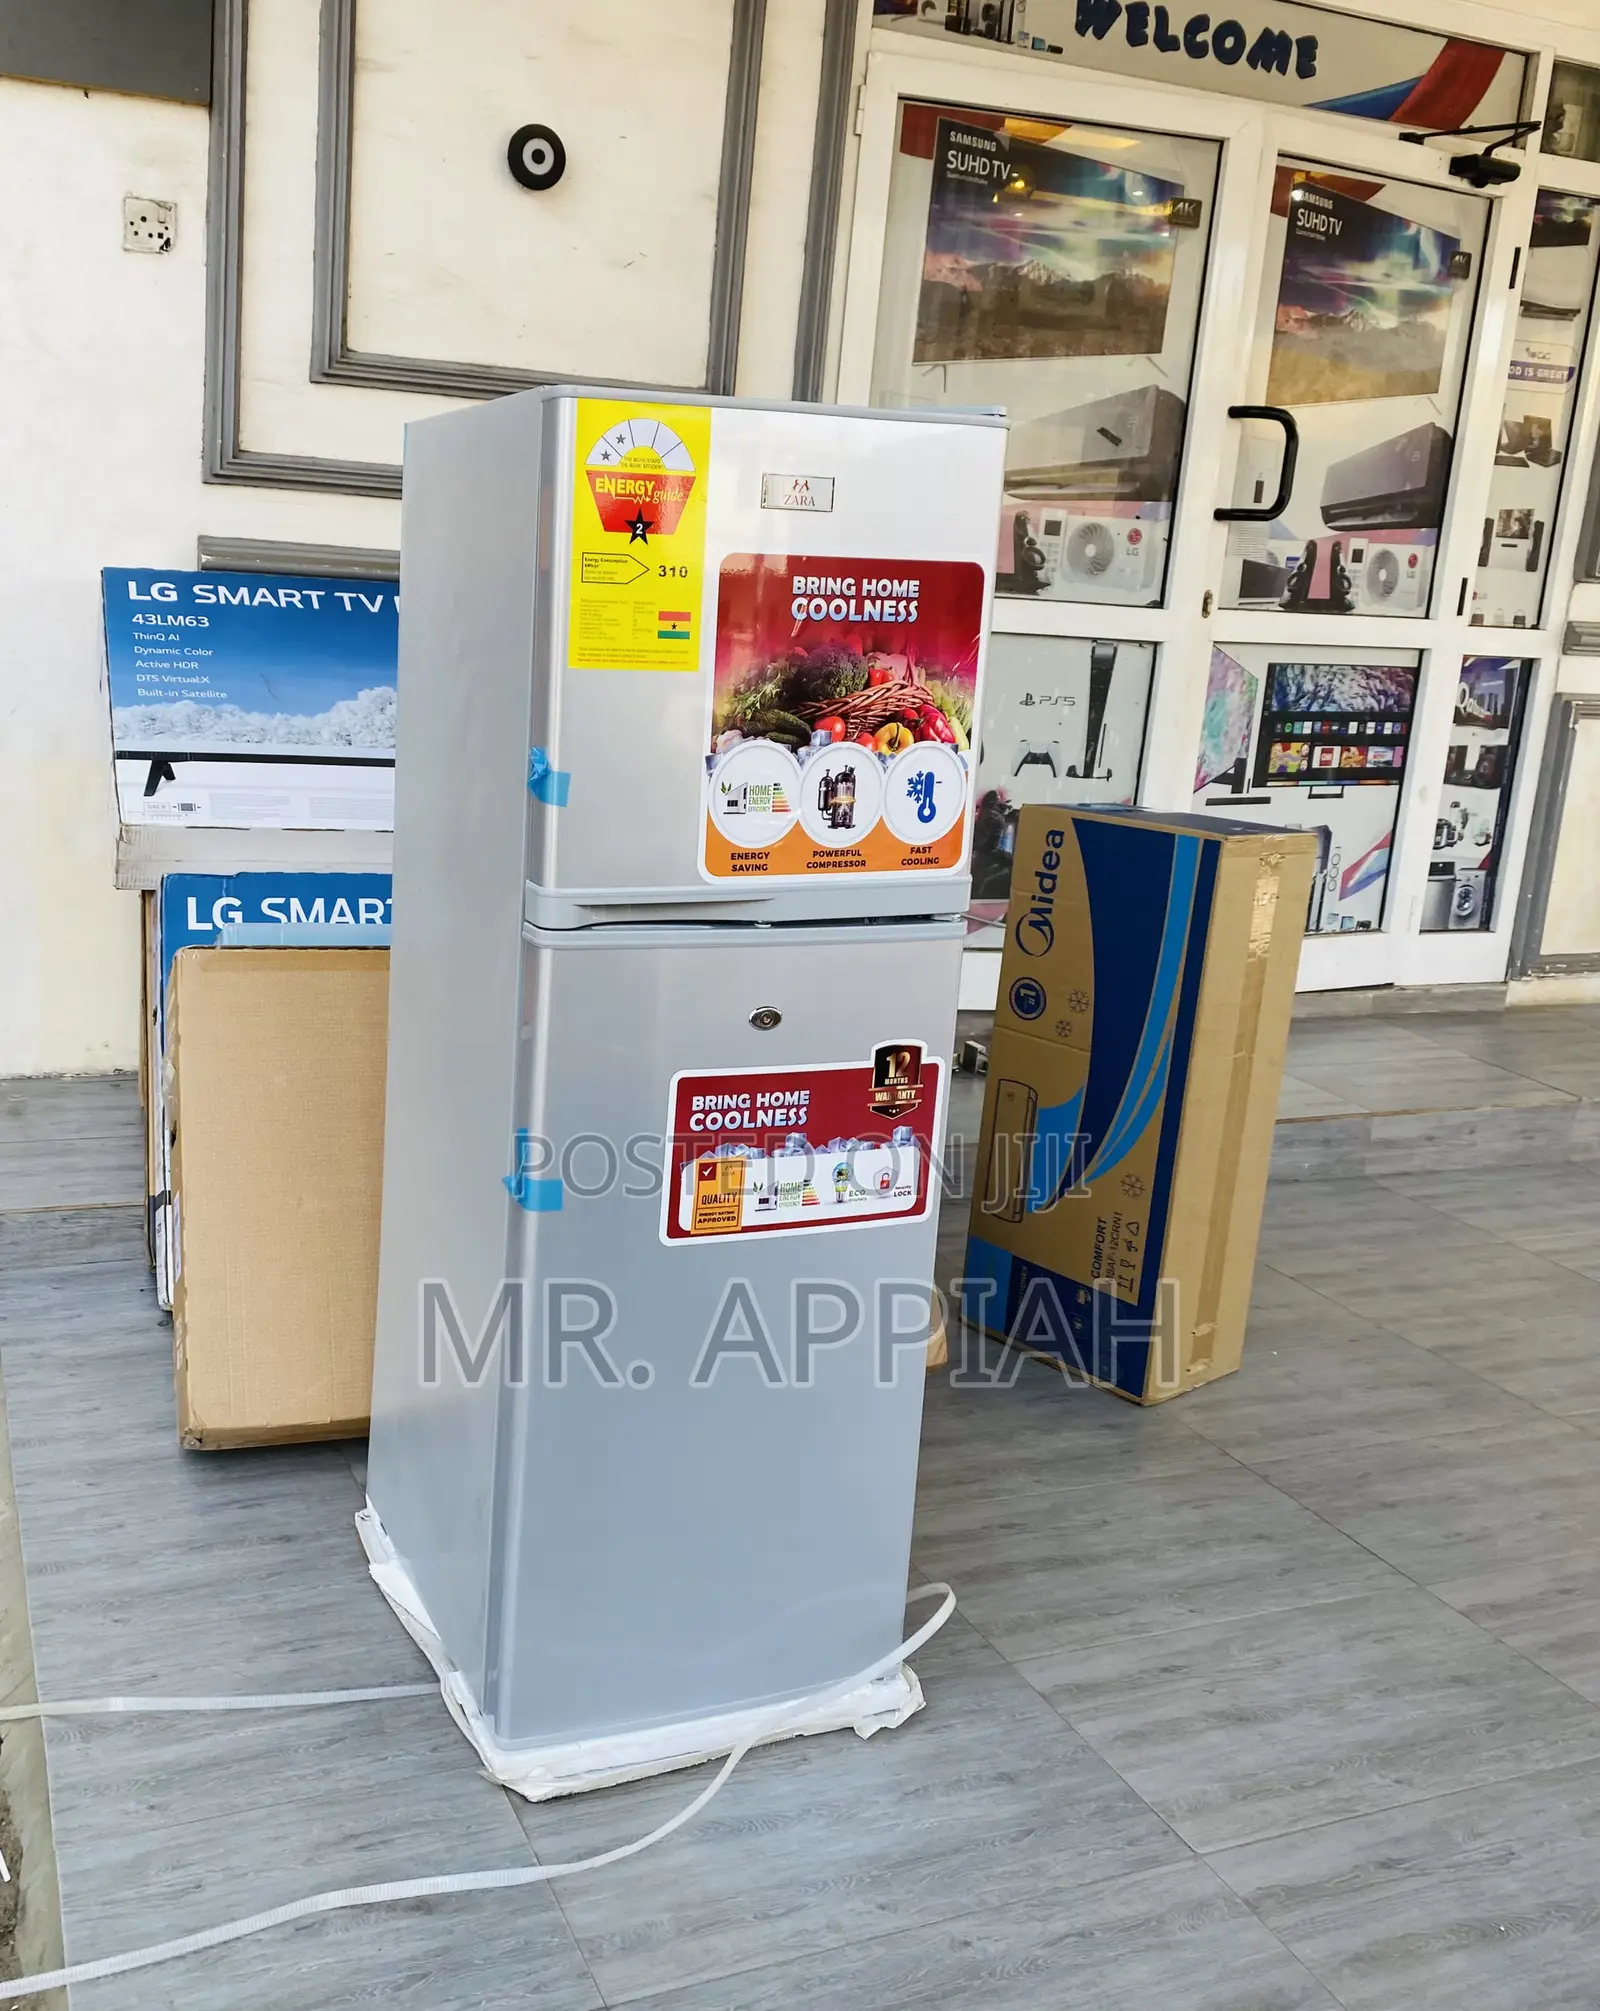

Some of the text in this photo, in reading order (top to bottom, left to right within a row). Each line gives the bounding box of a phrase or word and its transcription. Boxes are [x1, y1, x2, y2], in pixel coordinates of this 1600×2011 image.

[1075, 0, 1319, 79] WELCOME
[949, 131, 997, 152] SAMSUNG
[946, 150, 990, 175] SUHD
[991, 160, 1011, 180] TV
[1296, 208, 1328, 232] SUHD
[1328, 217, 1343, 236] TV
[1524, 367, 1534, 376] IS
[595, 475, 684, 504] ENERGY guide
[784, 495, 816, 506] ZARA
[636, 523, 644, 535] 2
[658, 565, 688, 578] 310
[792, 575, 920, 598] BRING HOME
[127, 580, 178, 602] LG
[192, 584, 326, 610] SMART
[334, 592, 384, 613] TV
[791, 597, 919, 623] COOLNESS
[132, 613, 209, 627] 43LM63
[132, 632, 180, 641] ThinQ AI
[134, 646, 214, 656] Dynamic Color
[135, 660, 199, 669] Active HDR
[136, 673, 160, 682] DTS
[137, 688, 228, 699] Built-in Satellite
[1039, 695, 1076, 706] PS5
[749, 785, 772, 796] HOME
[748, 797, 772, 805] ENERGY
[731, 852, 770, 861] ENERGY
[812, 849, 862, 858] POWERFUL
[910, 846, 932, 855] FAST
[731, 863, 769, 872] SAVING
[806, 860, 867, 869] COMPRESSOR
[901, 857, 940, 866] COOLING
[1027, 829, 1065, 946] Midea
[187, 896, 392, 931] LG SMAR
[886, 1051, 911, 1078] 12
[692, 1090, 810, 1111] BRING HOME
[875, 1090, 916, 1102] WAANTY
[689, 1107, 807, 1132] COOLNESS
[780, 1181, 802, 1193] HOME
[849, 1189, 866, 1197] ECO
[701, 1192, 738, 1205] QUALITY
[697, 1216, 737, 1224] APPROVED
[1090, 1217, 1107, 1279] COMFORT
